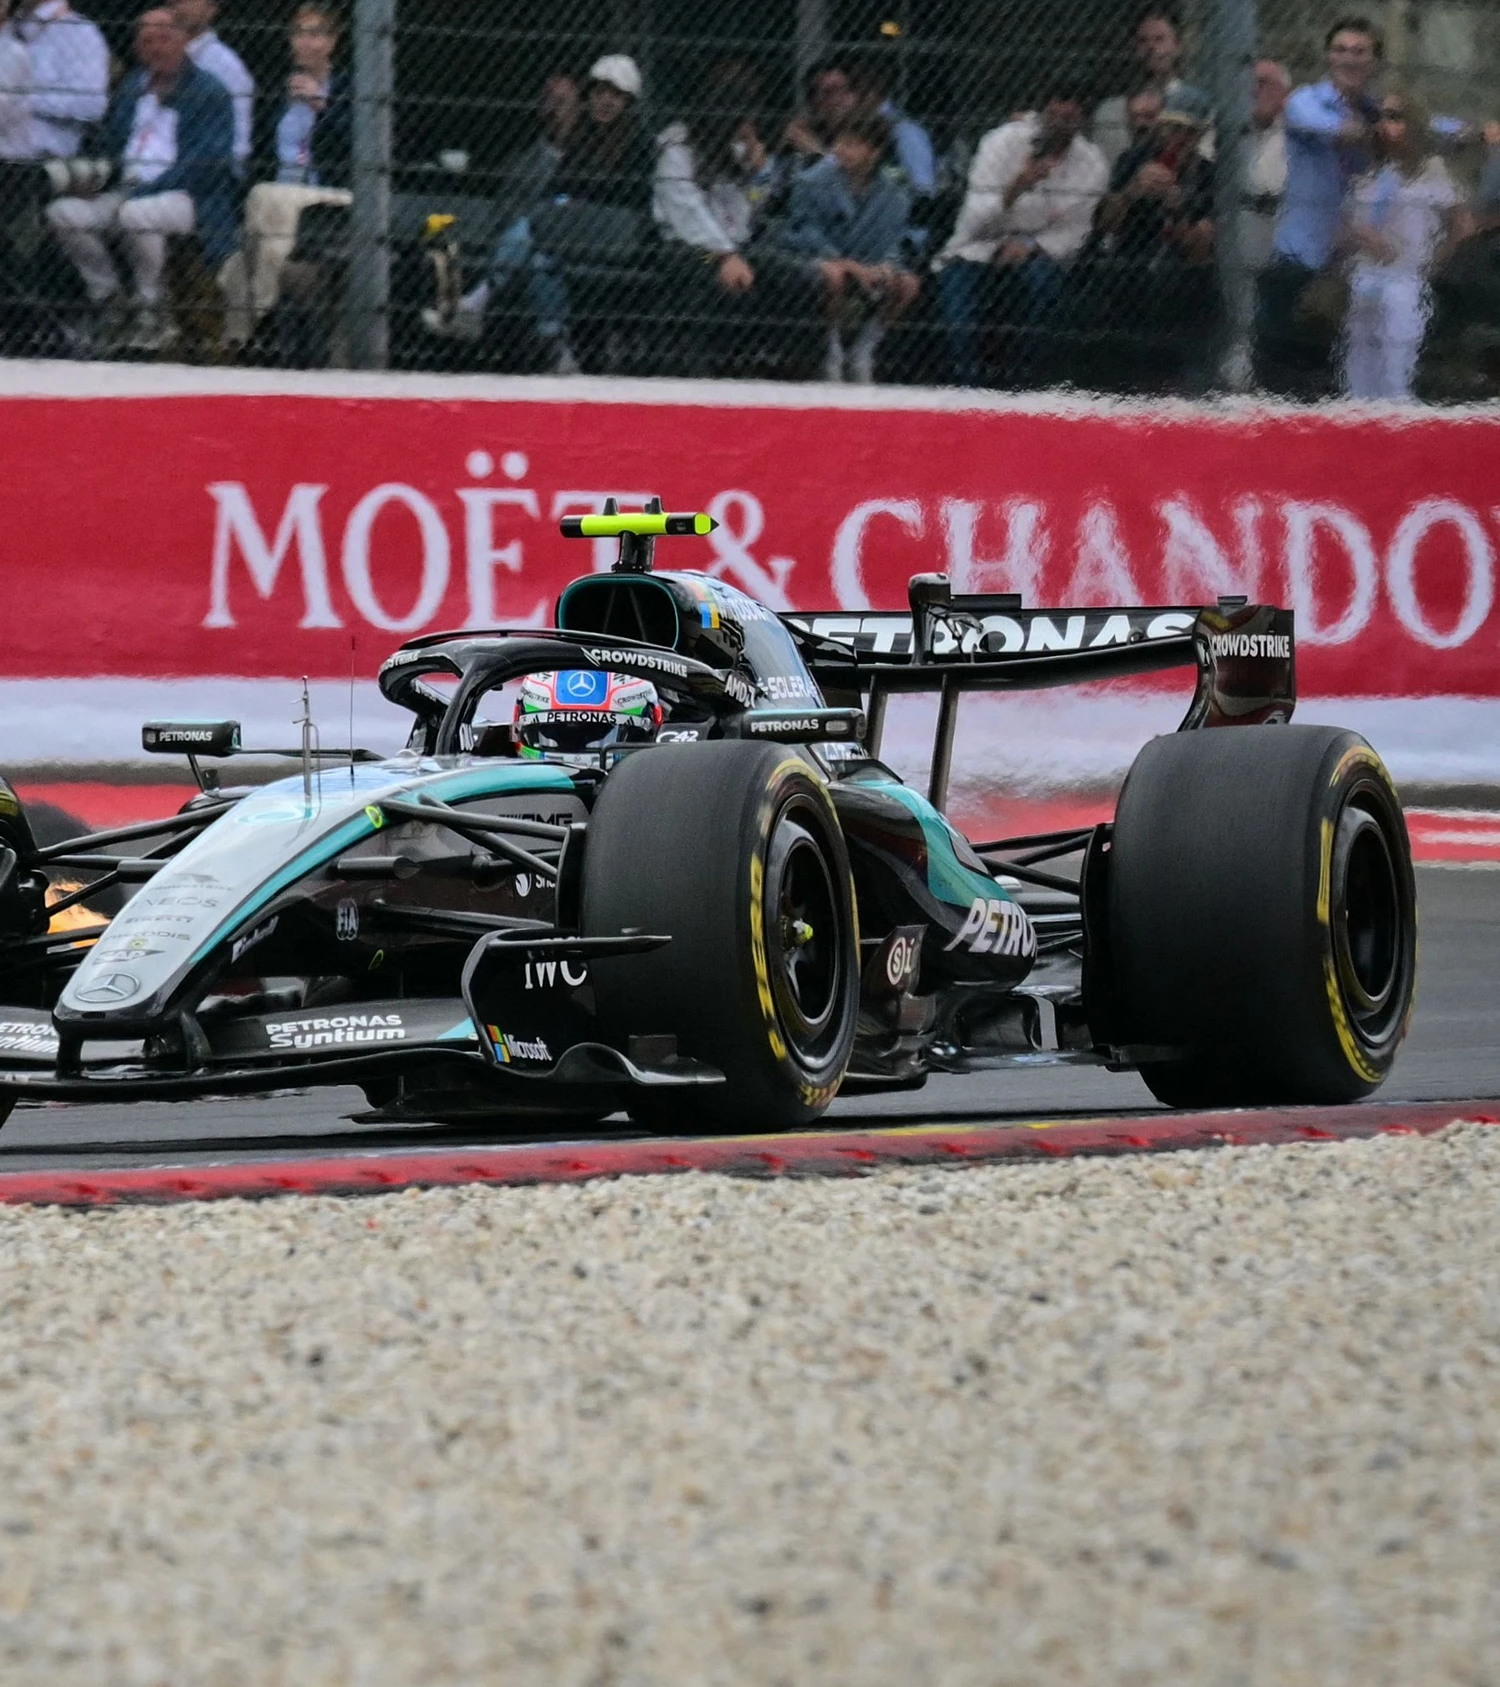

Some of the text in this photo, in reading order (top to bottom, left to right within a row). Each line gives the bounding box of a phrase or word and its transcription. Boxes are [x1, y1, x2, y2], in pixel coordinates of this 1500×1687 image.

[830, 493, 1500, 649] CHANDO
[788, 614, 1197, 656] ETRONAS
[1211, 634, 1290, 657] CROWDSTRIKE
[591, 648, 688, 678] CROWDSTRIKE
[724, 674, 750, 705] AMD
[547, 712, 617, 724] PETRONAS
[751, 718, 819, 733] PETRONAS
[159, 729, 213, 742] PETRONAS
[525, 945, 588, 989] IWC
[265, 1014, 402, 1035] PETRONAS
[269, 1027, 406, 1049] Syntium
[503, 1033, 552, 1061] Microsoft
